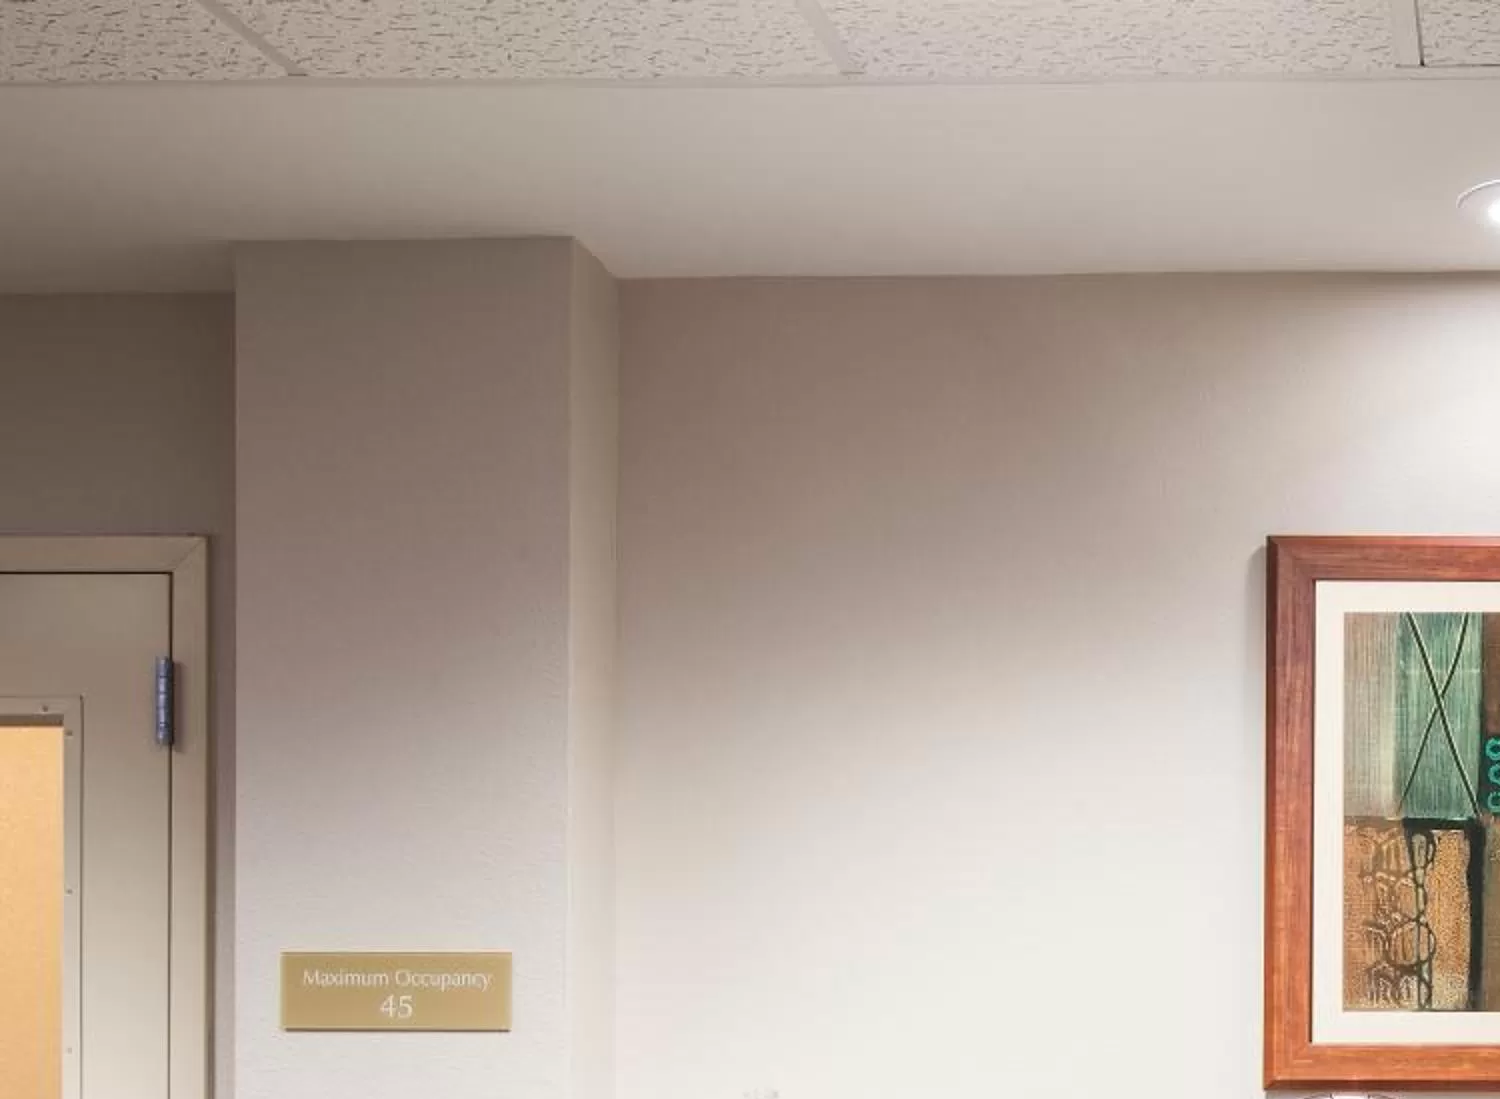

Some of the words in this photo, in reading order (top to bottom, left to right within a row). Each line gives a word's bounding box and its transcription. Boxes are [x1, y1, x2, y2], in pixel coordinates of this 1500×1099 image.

[303, 969, 389, 988] Maximum
[395, 969, 491, 992] Occupancy
[380, 994, 414, 1018] 45
